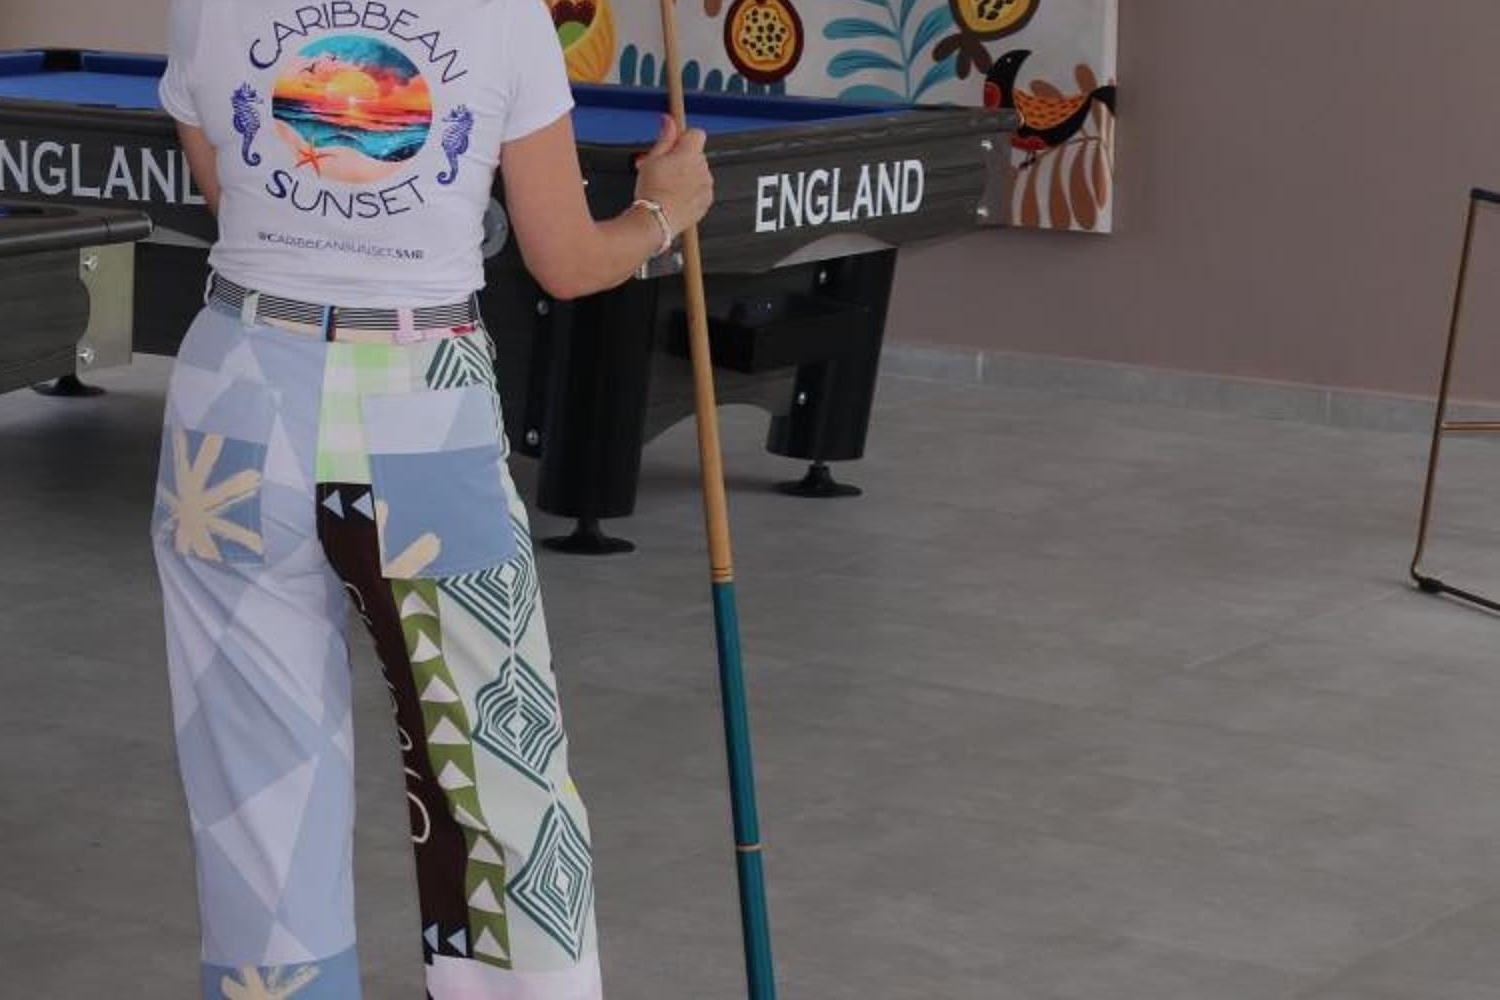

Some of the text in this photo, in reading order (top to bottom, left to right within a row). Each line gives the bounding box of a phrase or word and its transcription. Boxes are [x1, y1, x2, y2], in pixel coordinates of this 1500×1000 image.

[250, 0, 468, 83] CARIBBEAN
[265, 169, 425, 219] SUNSET
[755, 159, 925, 233] ENGLAND
